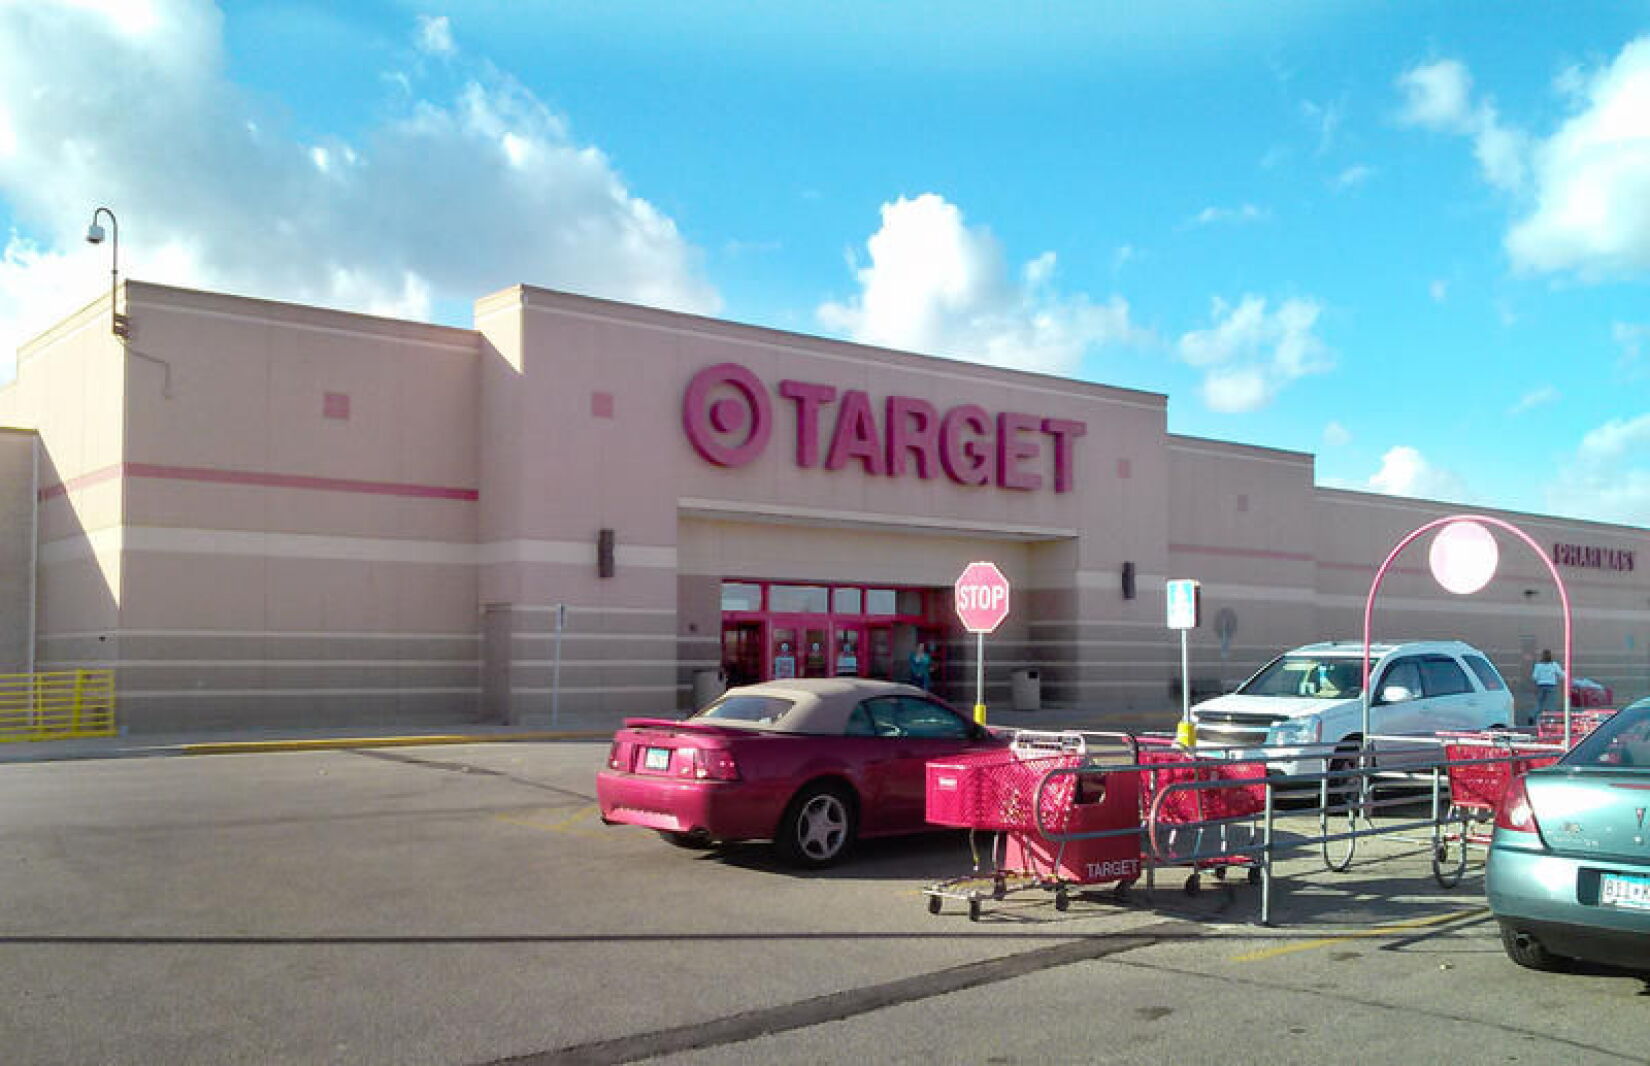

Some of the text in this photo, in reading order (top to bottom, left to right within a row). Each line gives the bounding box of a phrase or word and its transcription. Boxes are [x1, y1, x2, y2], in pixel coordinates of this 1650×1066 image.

[779, 379, 1087, 494] TARGET
[959, 585, 1004, 610] STOP
[1087, 859, 1139, 878] TARGET
